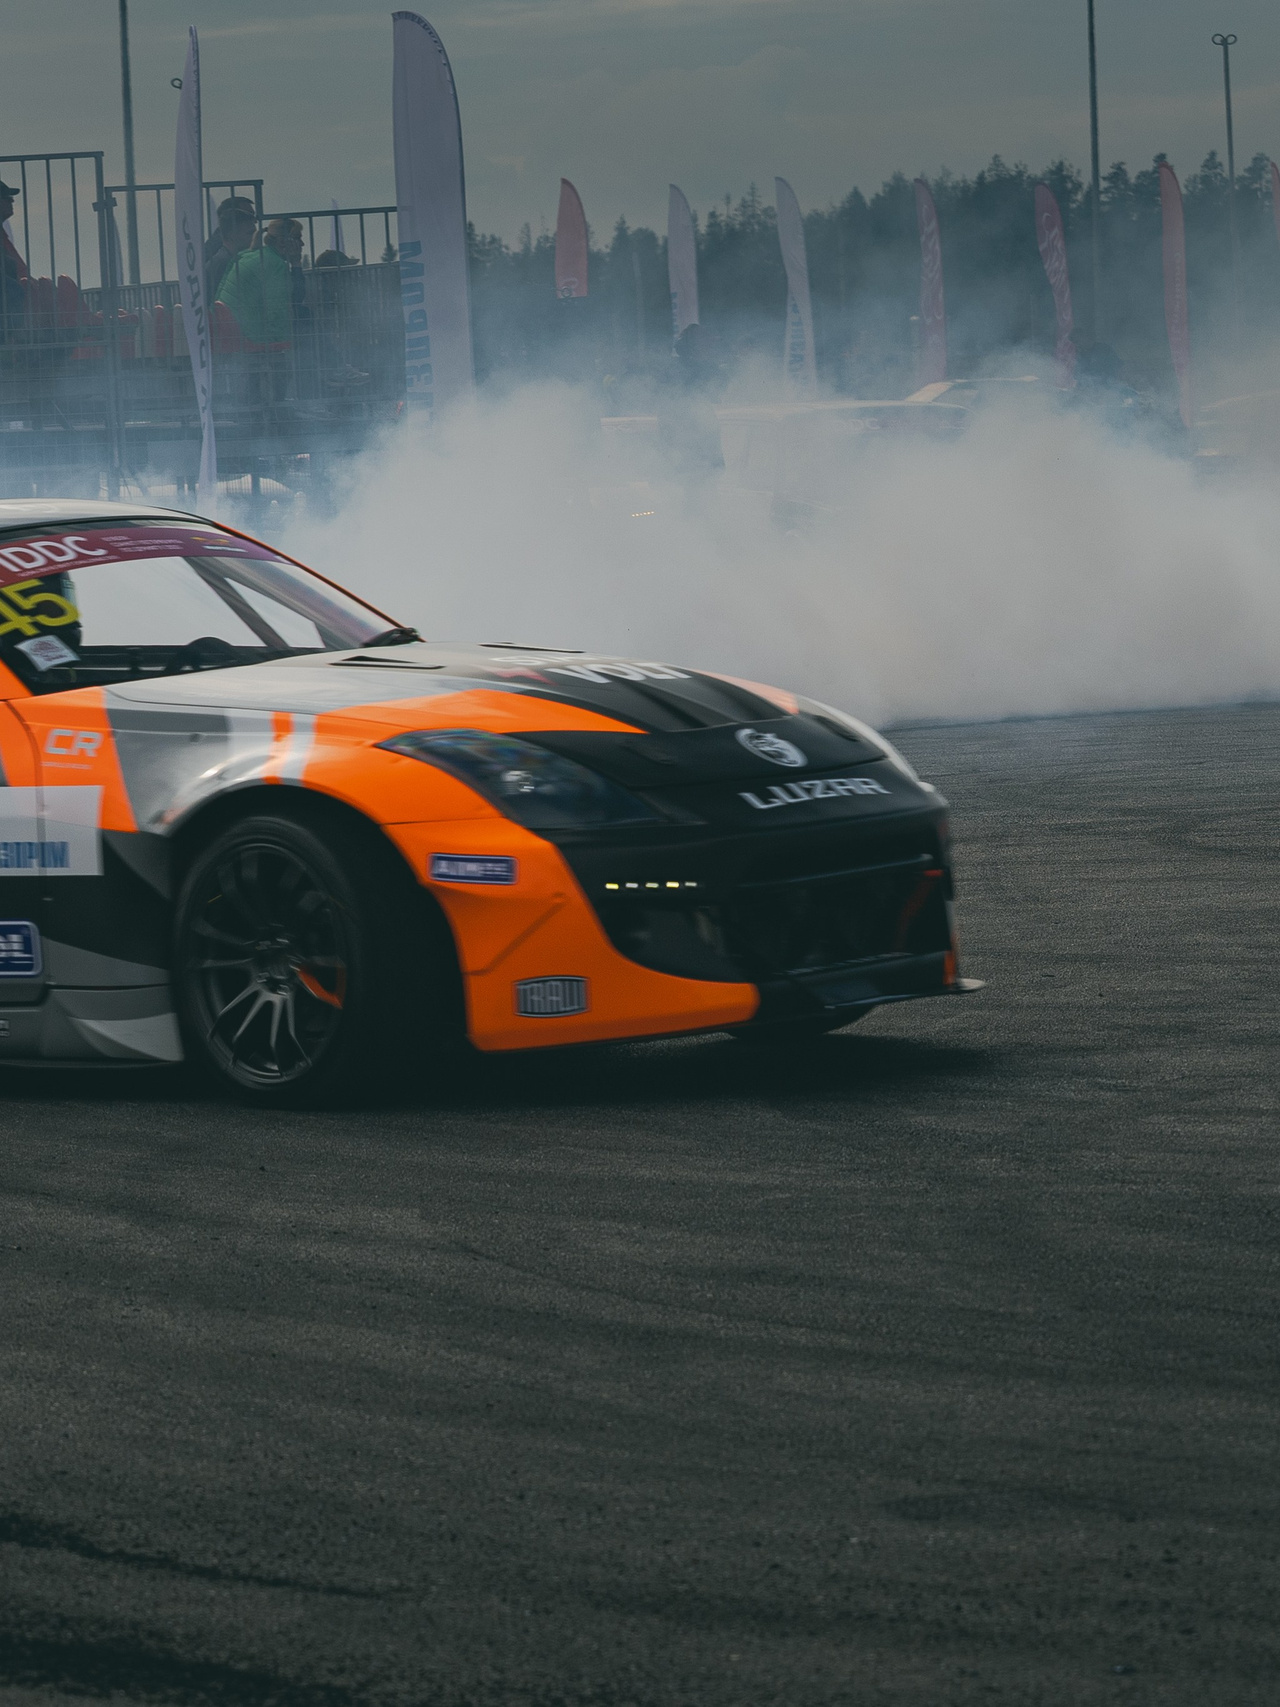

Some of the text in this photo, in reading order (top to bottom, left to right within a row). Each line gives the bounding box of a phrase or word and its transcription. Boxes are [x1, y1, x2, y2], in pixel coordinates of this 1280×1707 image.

[543, 661, 694, 684] VOLT
[44, 728, 104, 758] CR
[738, 778, 893, 810] LUZAR
